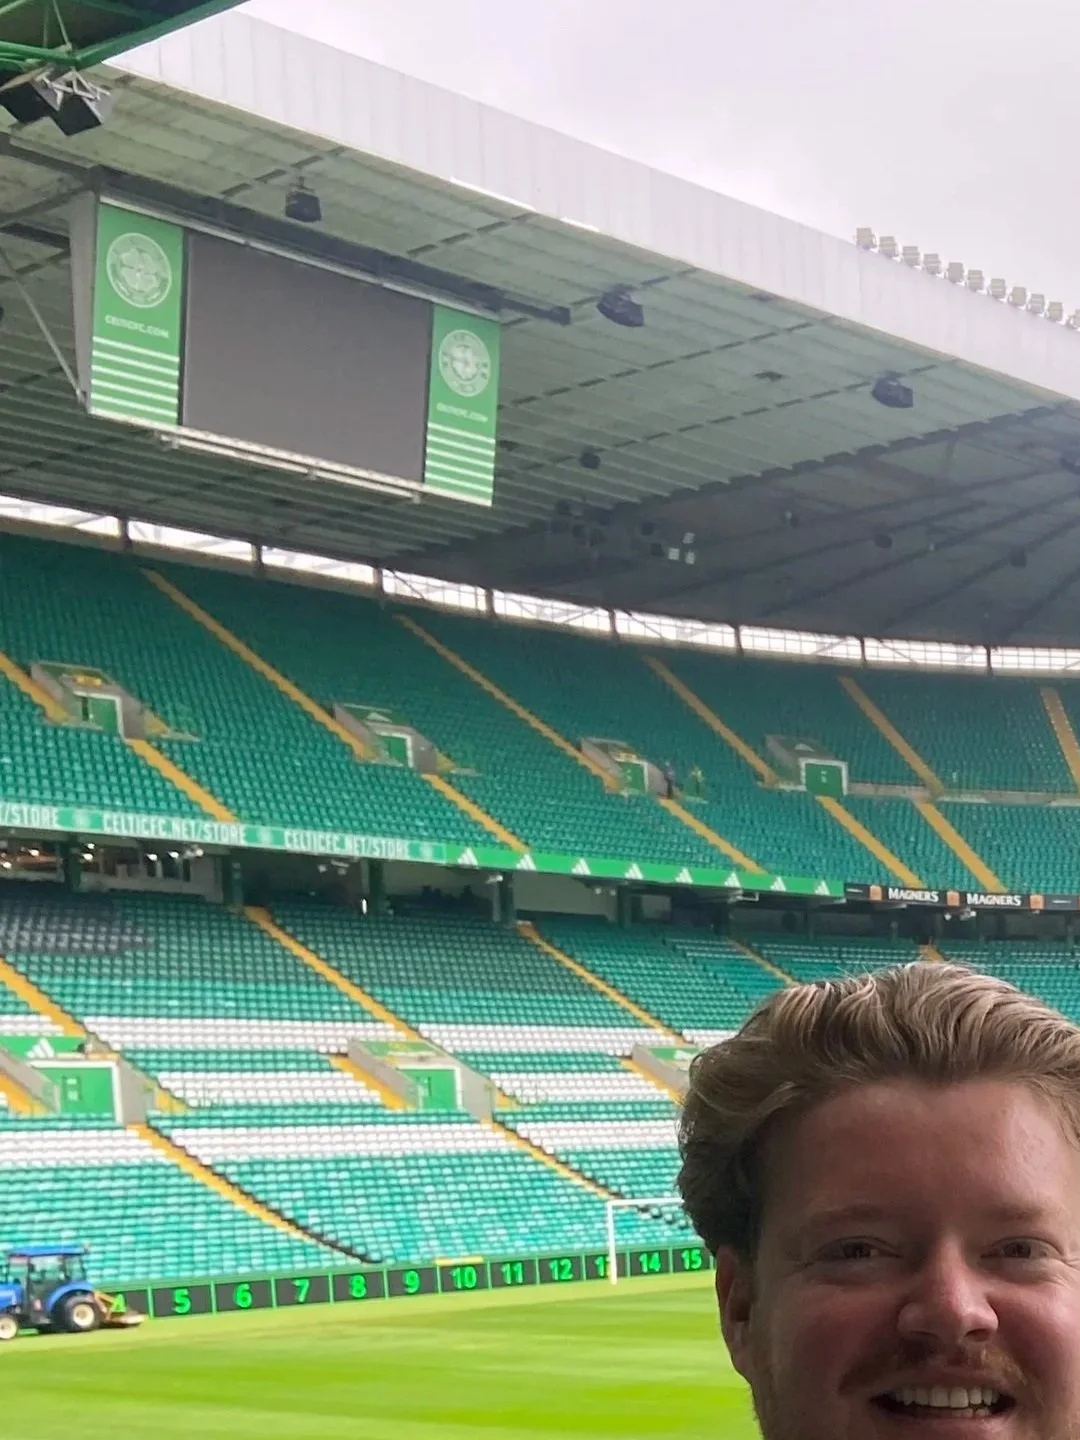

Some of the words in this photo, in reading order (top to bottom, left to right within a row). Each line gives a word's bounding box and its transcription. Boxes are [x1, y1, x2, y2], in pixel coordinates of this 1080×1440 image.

[103, 811, 246, 846] CELTICFC.NET/STORE
[888, 886, 939, 903] MAGNERS
[966, 892, 1022, 907] MAGNERS
[174, 1287, 192, 1315] 5
[234, 1282, 252, 1309] 6
[290, 1277, 310, 1303] 7
[350, 1273, 368, 1299] 8
[403, 1268, 421, 1295] 9
[451, 1265, 478, 1291] 10
[500, 1260, 524, 1286] 11
[549, 1257, 573, 1283] 12
[639, 1251, 662, 1273] 14
[681, 1247, 703, 1271] 15
